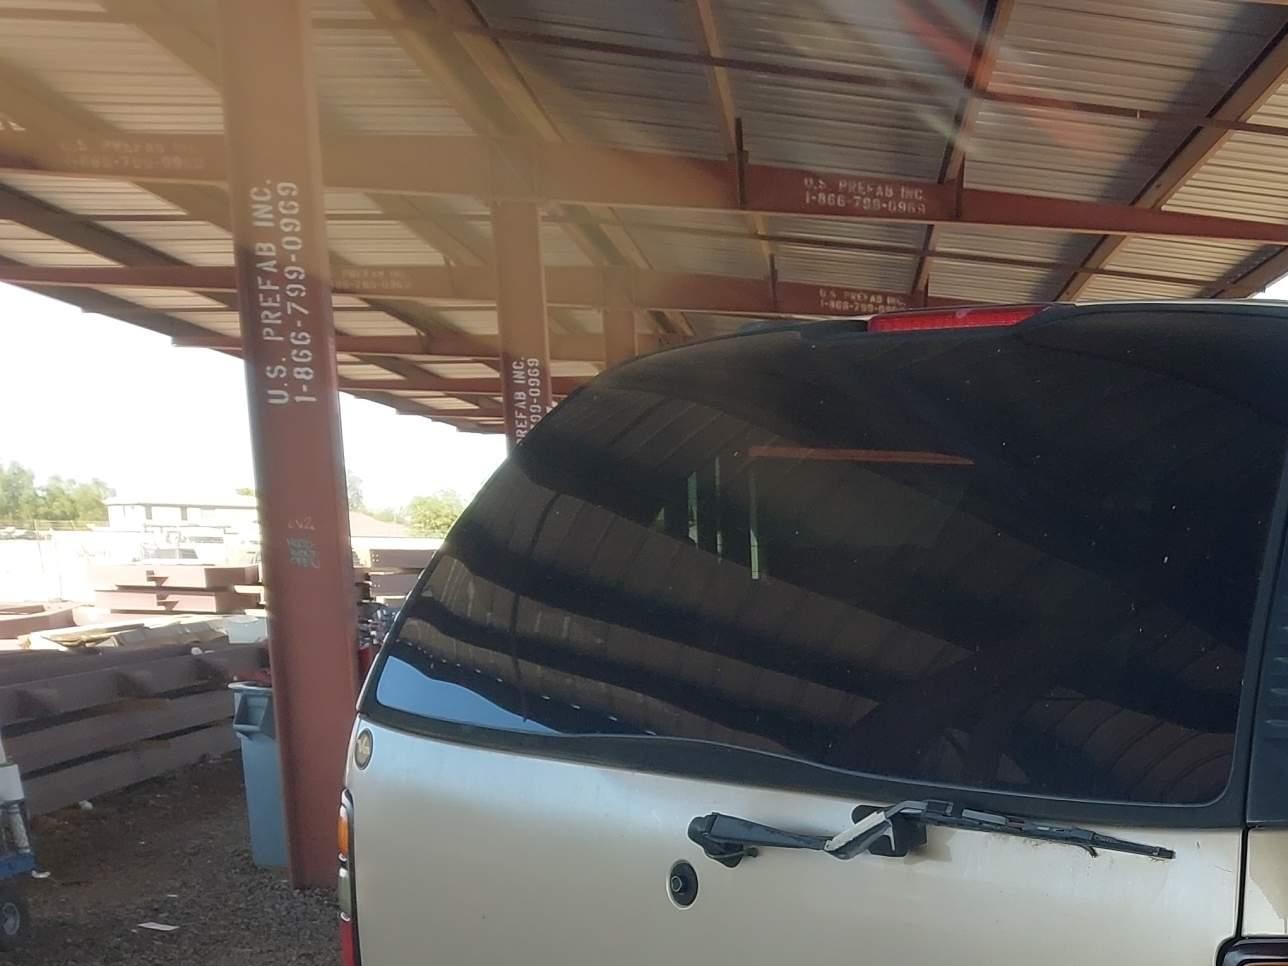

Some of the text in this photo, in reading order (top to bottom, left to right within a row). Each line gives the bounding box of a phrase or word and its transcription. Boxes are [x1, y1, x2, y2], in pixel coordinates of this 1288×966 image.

[251, 179, 289, 404] U.S. PREFAB INC.
[277, 182, 317, 402] 1-866-799-0969
[527, 358, 542, 429] 99-0969
